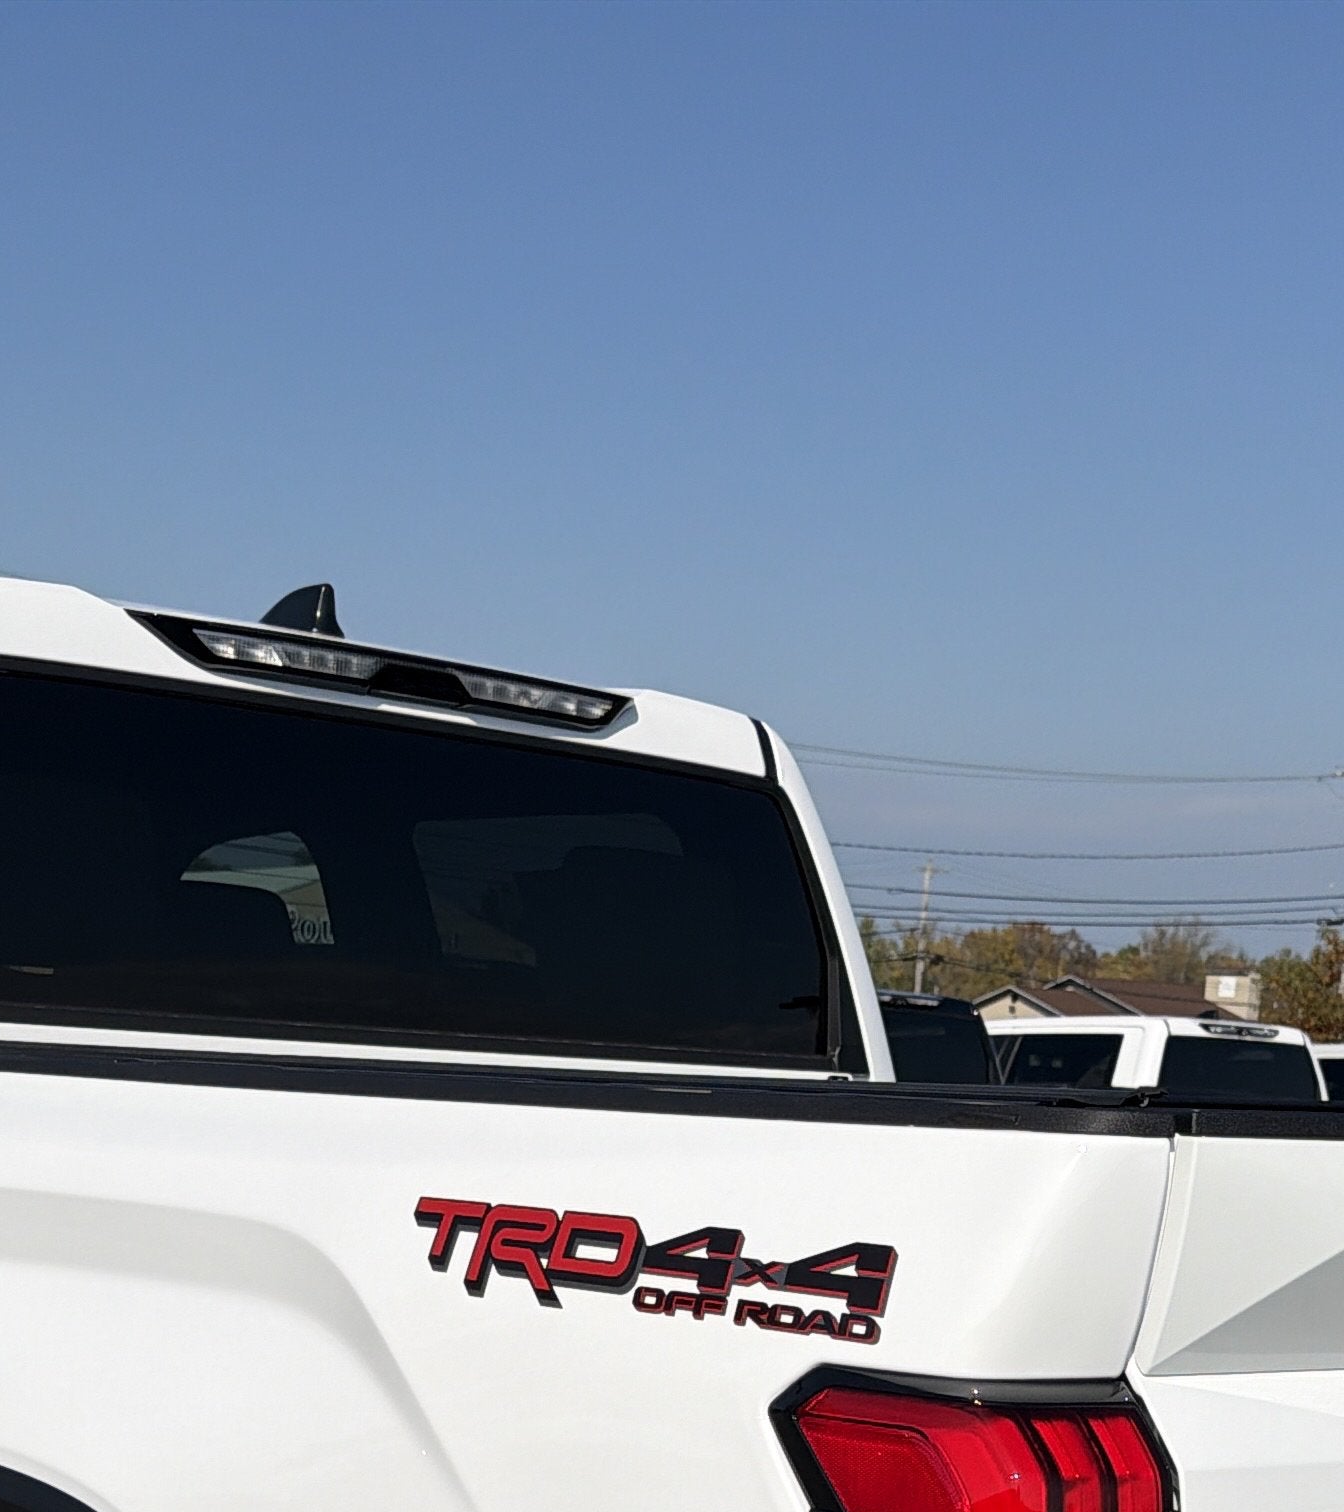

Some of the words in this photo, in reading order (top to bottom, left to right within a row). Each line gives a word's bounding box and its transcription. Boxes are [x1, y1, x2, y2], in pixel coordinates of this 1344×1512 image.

[414, 1196, 647, 1309] TRD
[633, 1286, 729, 1321] OFF
[734, 1298, 881, 1345] ROAD
